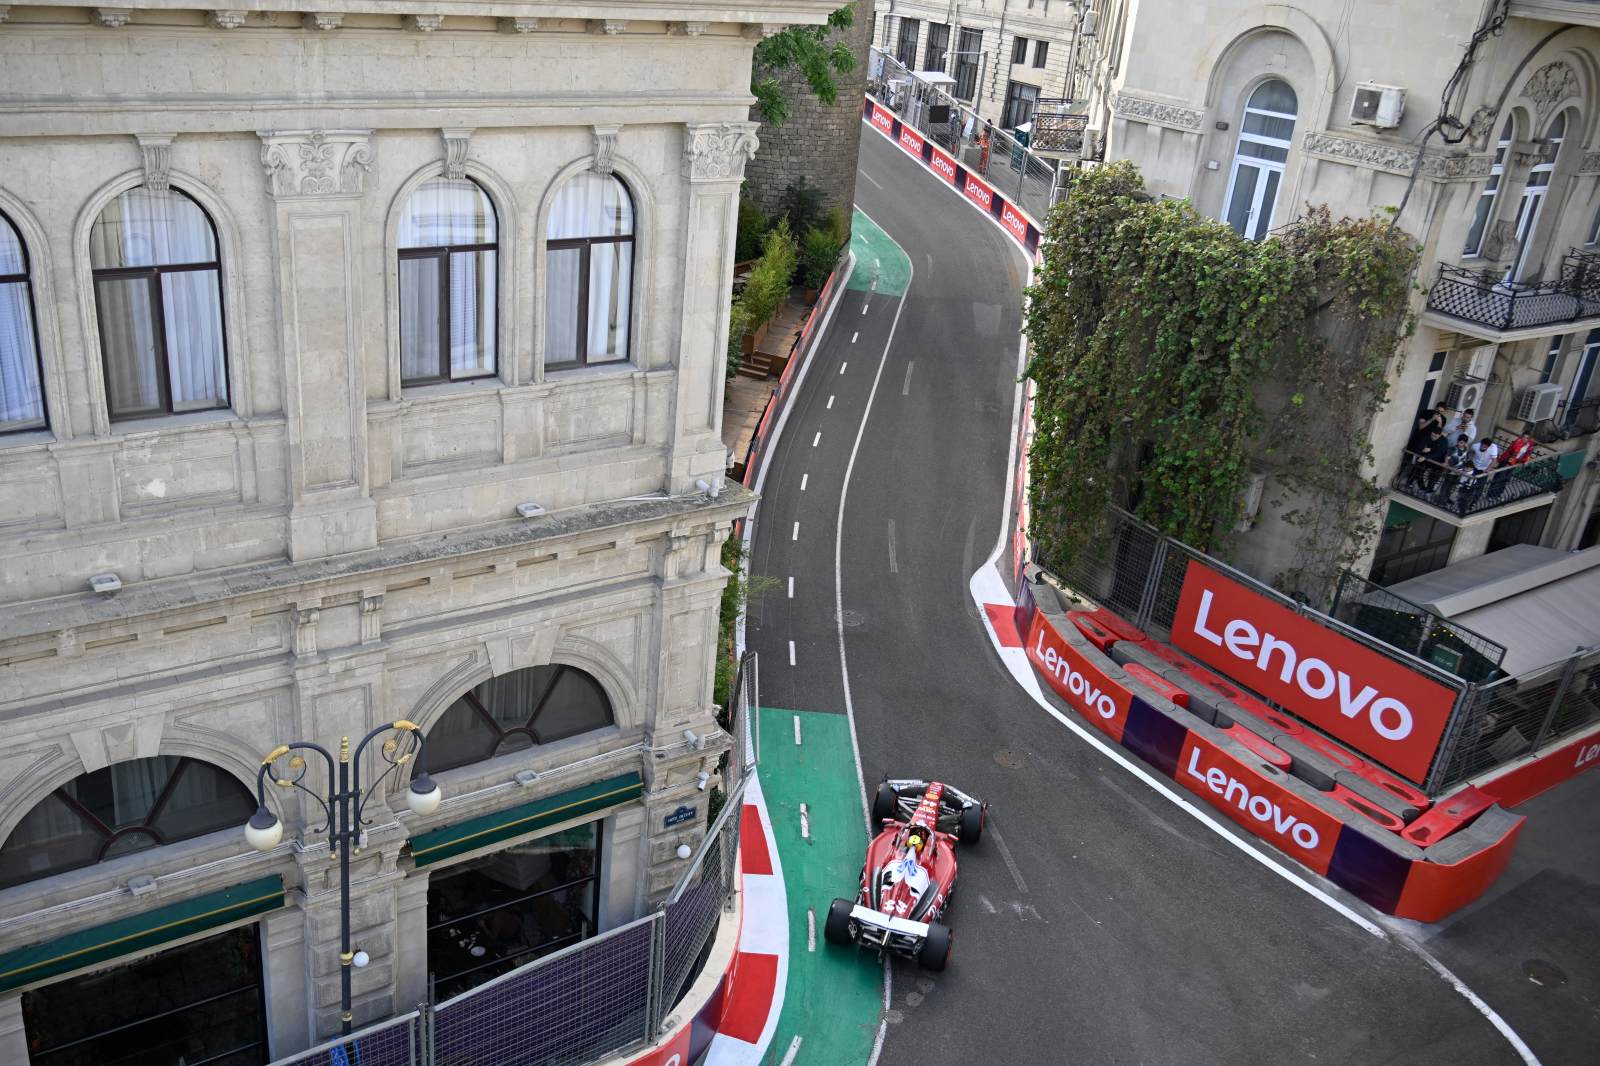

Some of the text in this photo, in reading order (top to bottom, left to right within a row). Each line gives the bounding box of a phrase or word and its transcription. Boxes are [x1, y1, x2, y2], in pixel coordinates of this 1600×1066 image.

[872, 107, 891, 129] Lenovo
[901, 127, 921, 153] Lenovo
[932, 151, 954, 177] Lenovo
[966, 177, 990, 205] Lenovo
[1002, 205, 1025, 235] Lenovo
[1036, 629, 1116, 719] Lenovo
[1194, 589, 1413, 741] Lenovo
[1187, 747, 1319, 850] Lenovo
